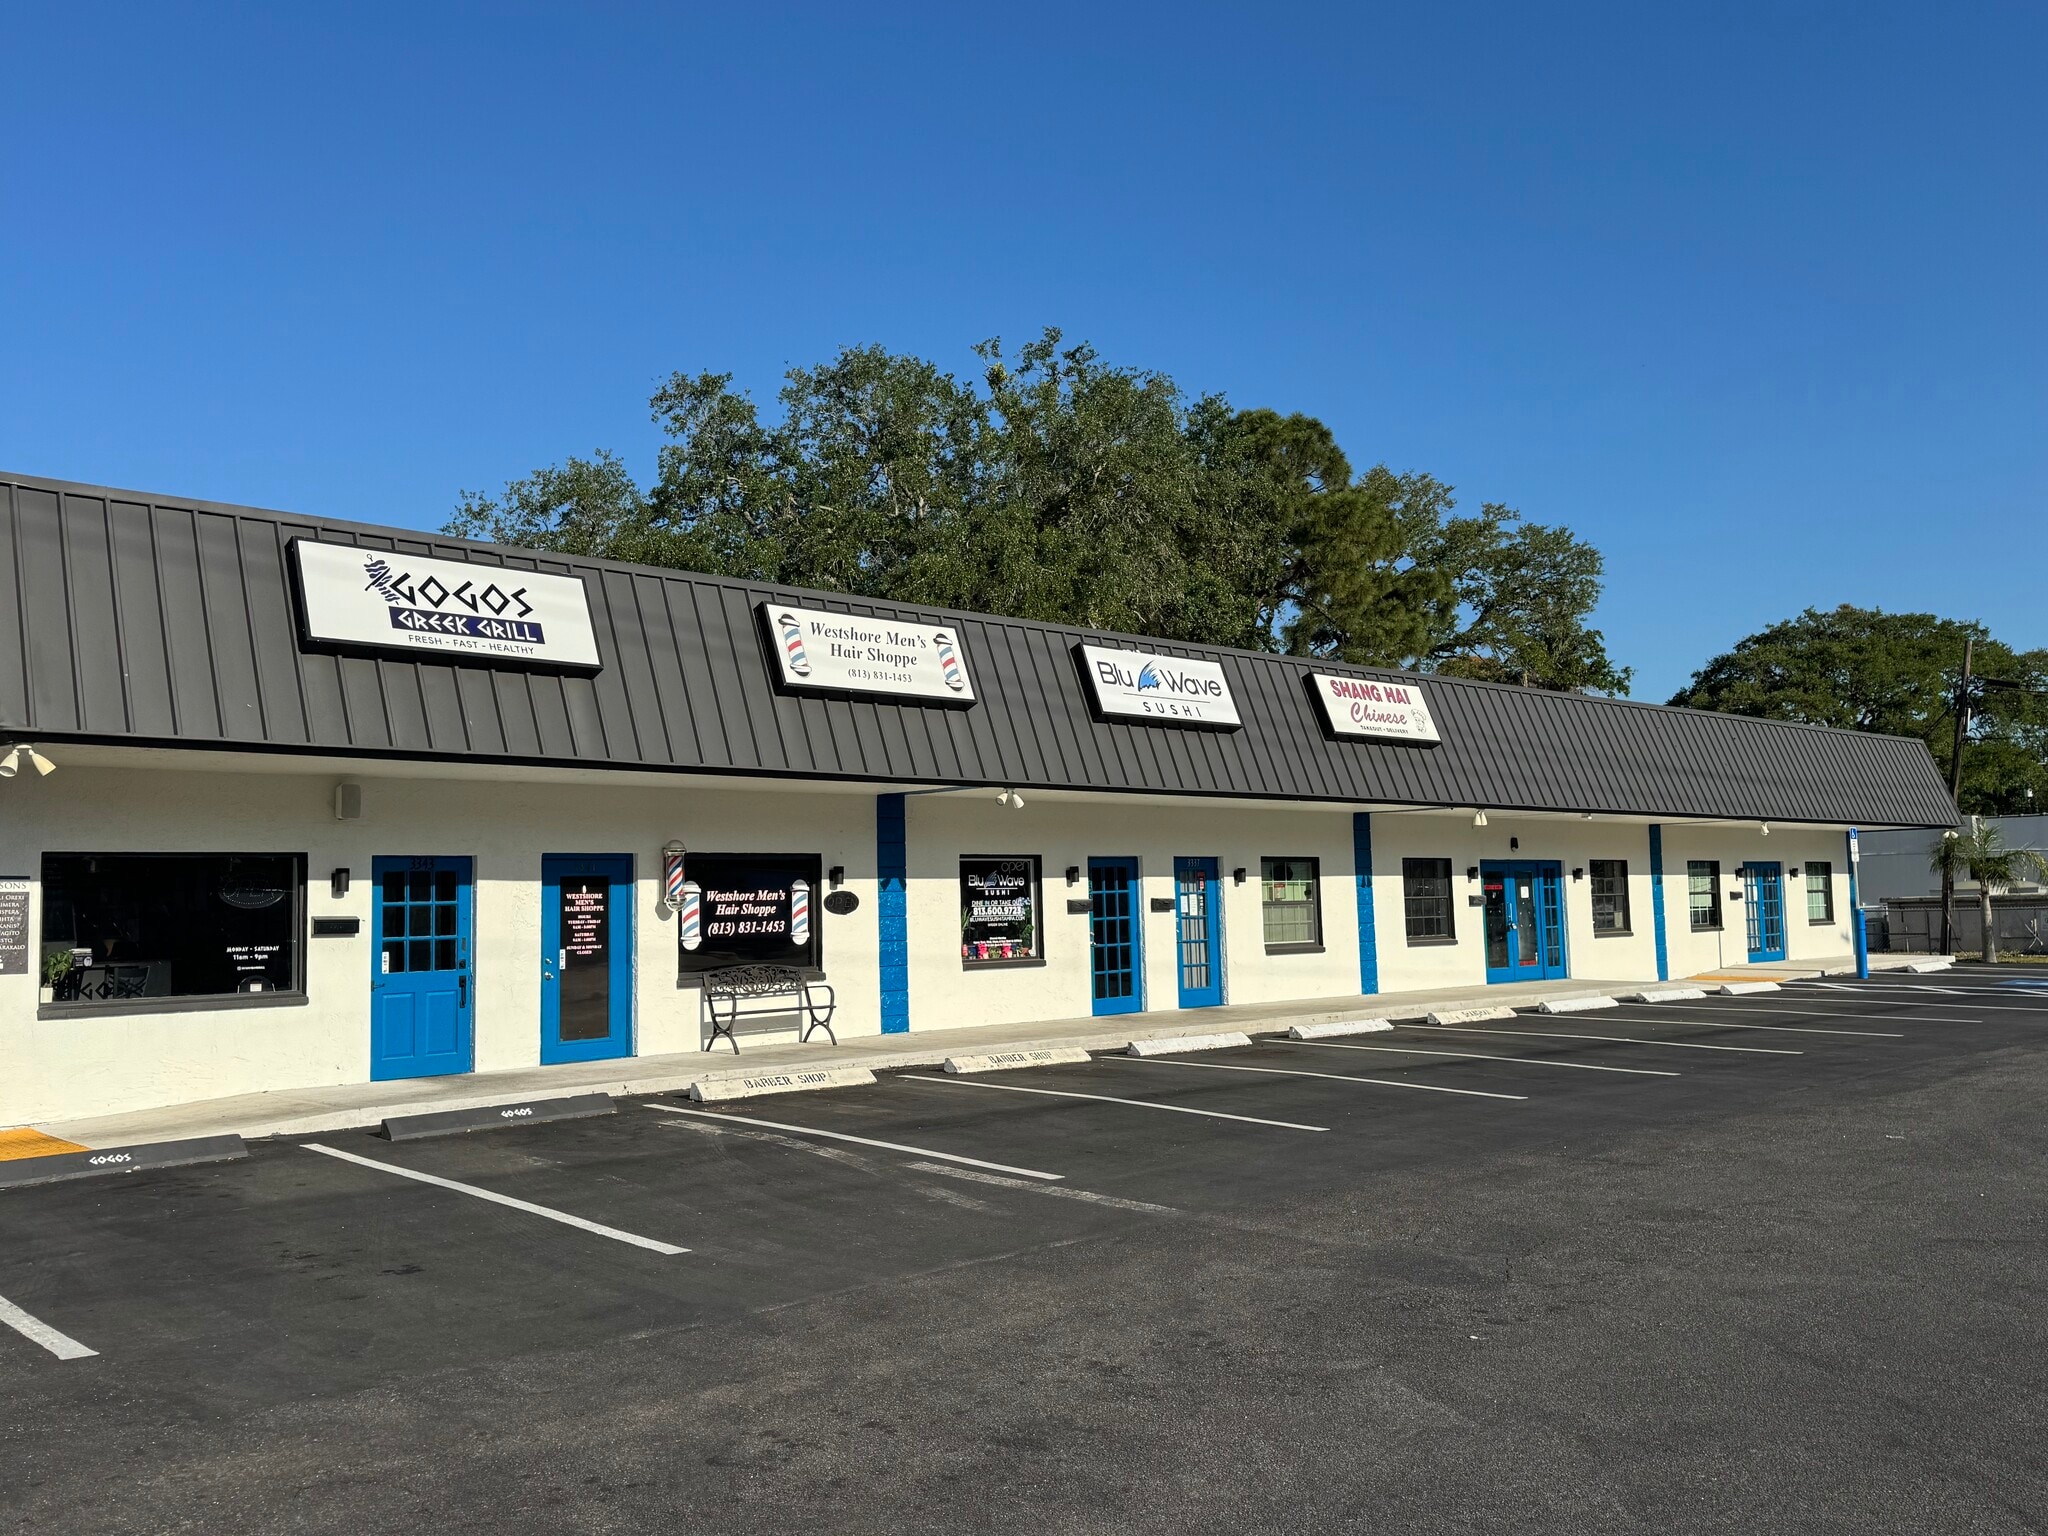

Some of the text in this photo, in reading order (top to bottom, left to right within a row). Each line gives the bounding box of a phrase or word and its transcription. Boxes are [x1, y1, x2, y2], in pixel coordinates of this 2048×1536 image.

[390, 572, 533, 618] GOGOS
[398, 611, 537, 641] GREEK GRILL
[810, 621, 927, 649] Westshore Men's
[408, 634, 443, 645] FRESH
[453, 639, 479, 649] FAST
[489, 643, 535, 655] HEALTHY
[830, 643, 918, 668] Hair Shoppe
[848, 668, 912, 683] (813) 831-1453
[1096, 661, 1222, 697] Blu Wave
[1330, 679, 1411, 705] SHANG HAI
[1143, 701, 1202, 718] SUSHI
[1350, 702, 1407, 725] Chinese
[968, 874, 1025, 887] Blu Wave
[706, 889, 786, 902] Westshore Men's
[715, 903, 777, 917] Hair Shoppe
[973, 906, 1021, 916] 813.600.9723
[707, 920, 785, 937] (813) 831-1453
[987, 1053, 1027, 1063] BARBER
[743, 1072, 826, 1089] BARBER SHOP
[501, 1107, 532, 1117] GOGOS
[89, 1153, 132, 1165] GOGOS
